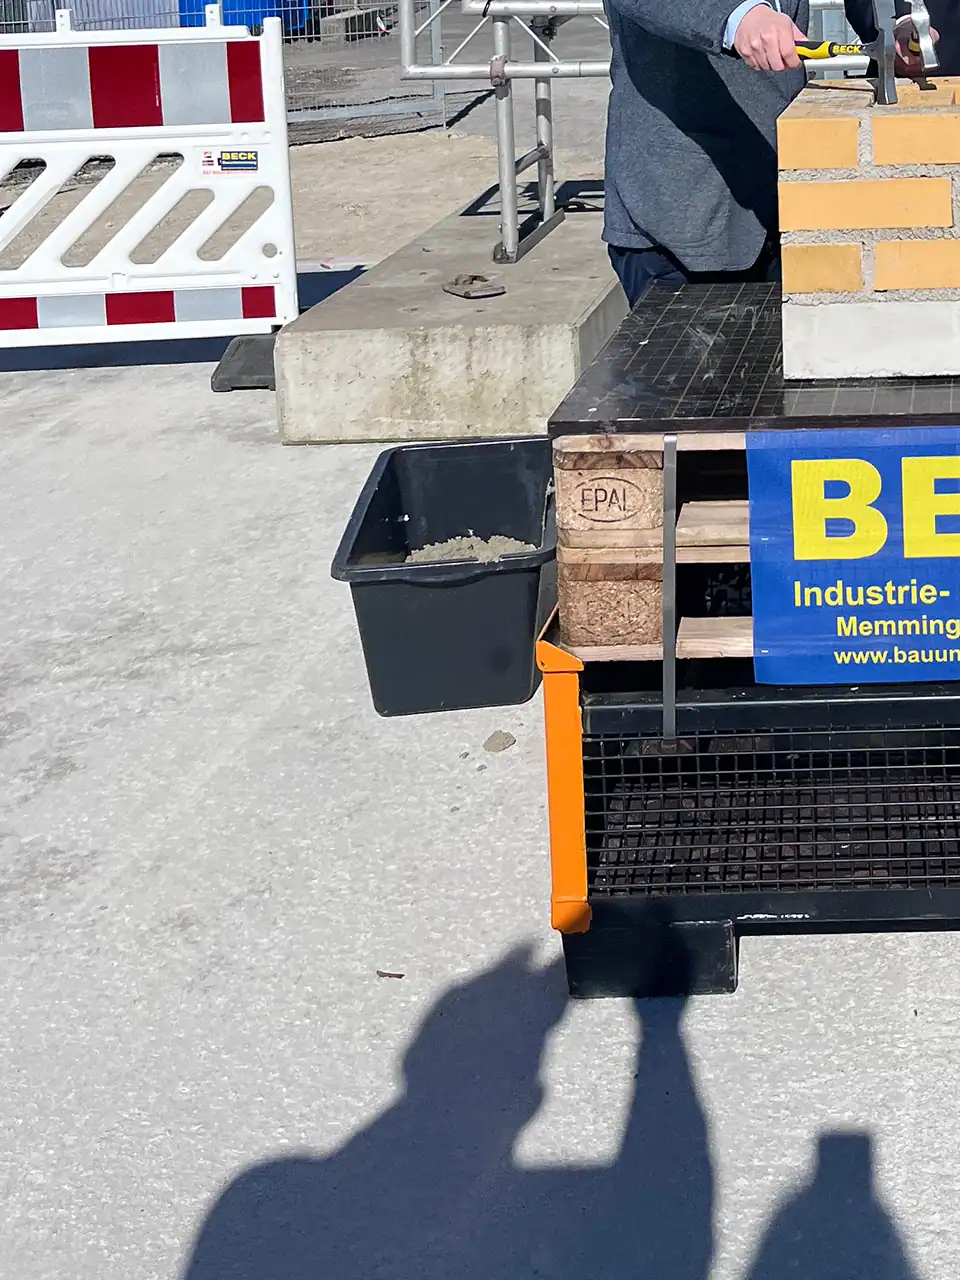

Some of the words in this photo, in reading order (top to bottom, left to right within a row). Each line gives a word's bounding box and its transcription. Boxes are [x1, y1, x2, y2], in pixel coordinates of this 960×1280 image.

[832, 45, 862, 54] BECK
[222, 152, 256, 160] BECK
[581, 488, 631, 513] EPAL
[794, 578, 950, 607] Industrie-
